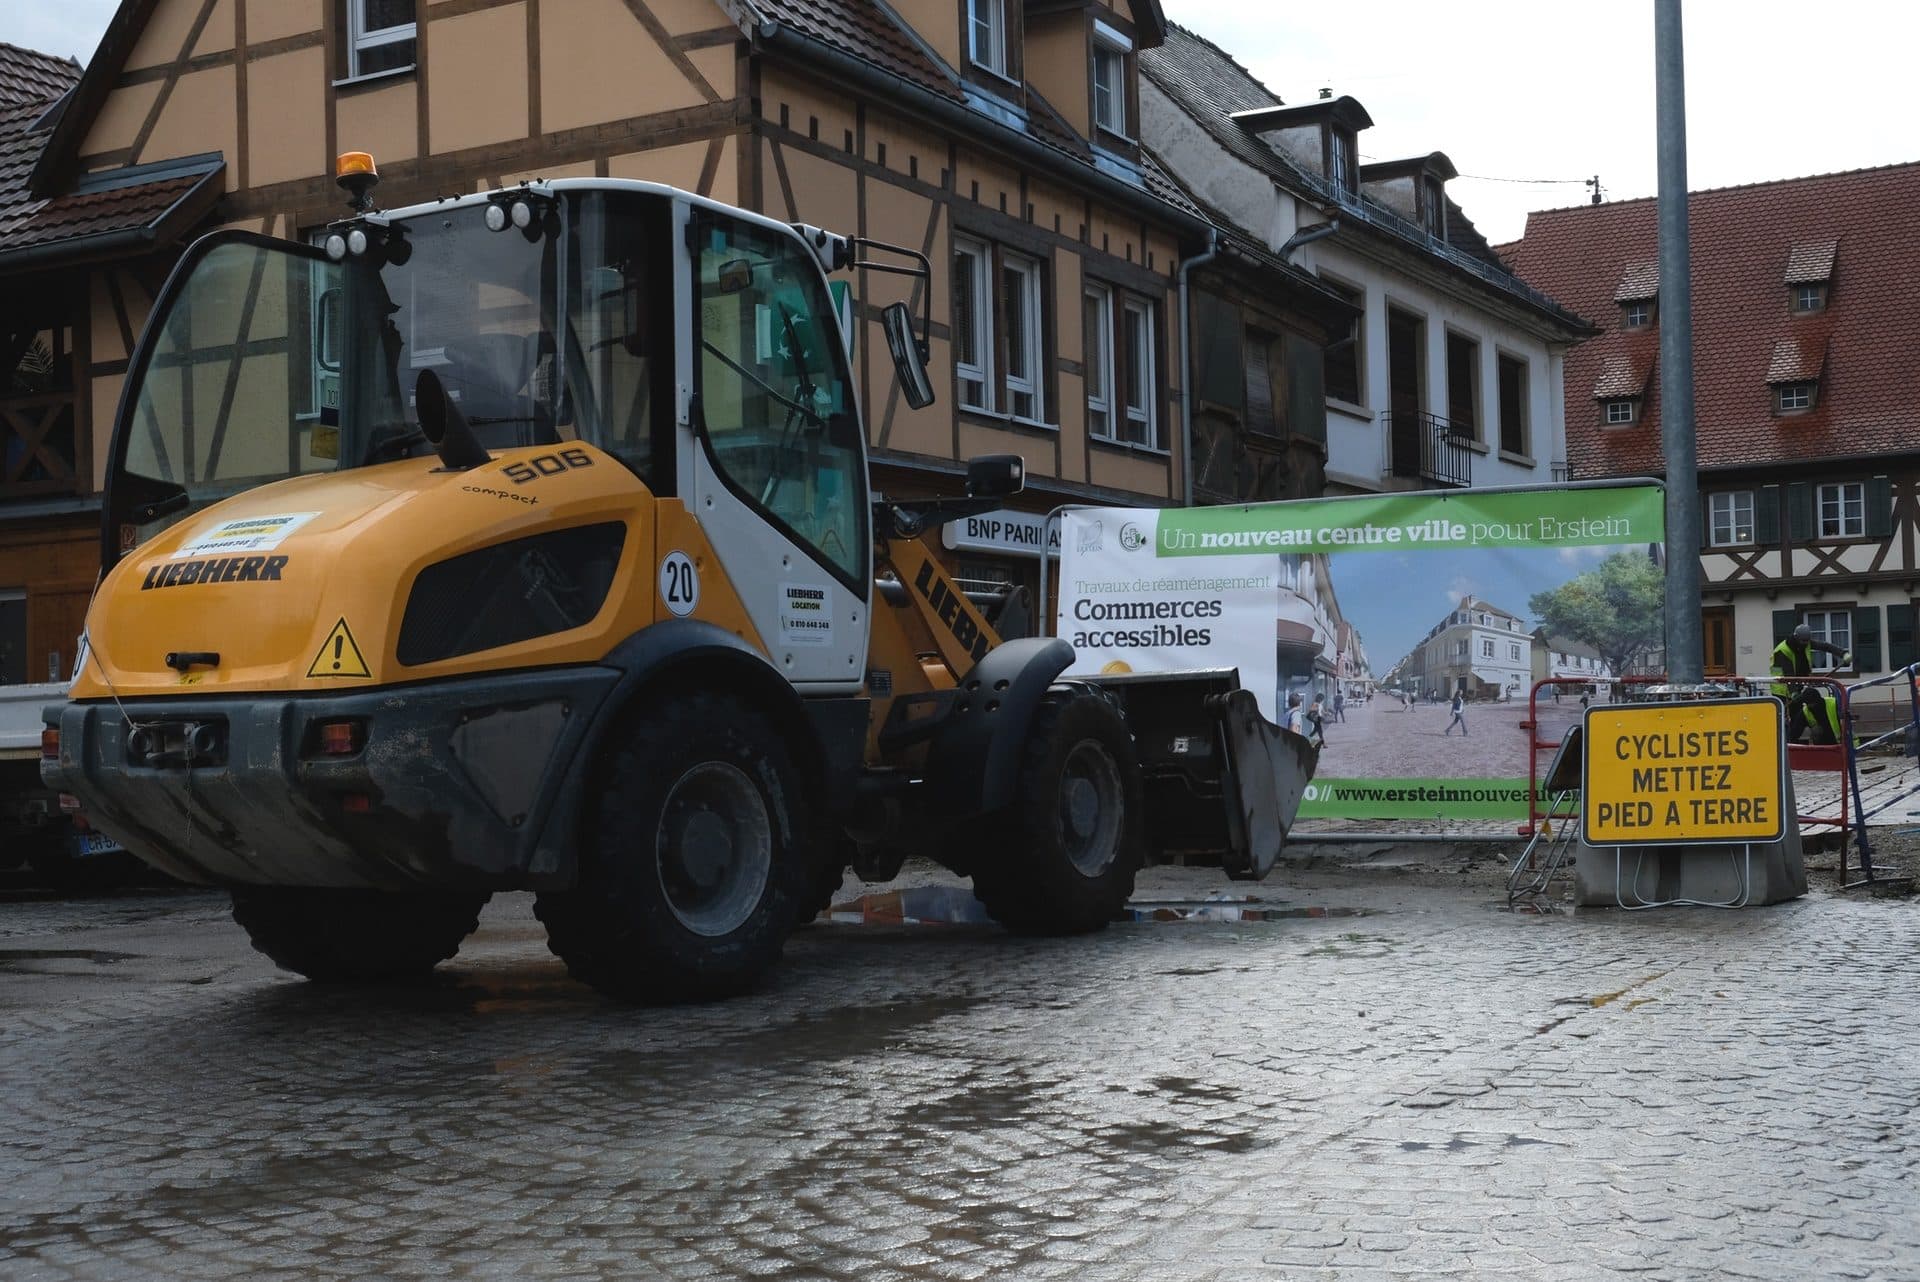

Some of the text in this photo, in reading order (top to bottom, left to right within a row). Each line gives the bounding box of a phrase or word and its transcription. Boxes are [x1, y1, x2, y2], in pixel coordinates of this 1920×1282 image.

[503, 449, 594, 484] 506
[462, 485, 539, 505] compact
[967, 518, 1001, 540] BNP
[1005, 523, 1062, 548] PARIA
[1163, 515, 1631, 549] Un nouveau centre ville pour Erstein
[141, 555, 289, 591] LIEBHERR
[667, 561, 693, 603] 20
[1075, 575, 1271, 594] Travaux de réaménagement
[787, 588, 825, 600] LIEBHERR
[792, 601, 820, 610] LOCATION
[1074, 599, 1222, 621] Commerces
[1073, 625, 1211, 648] accessibles
[1616, 730, 1749, 760] CYCLISTES
[1633, 765, 1732, 793] METTEZ
[1598, 797, 1768, 828] PIED A TERRE
